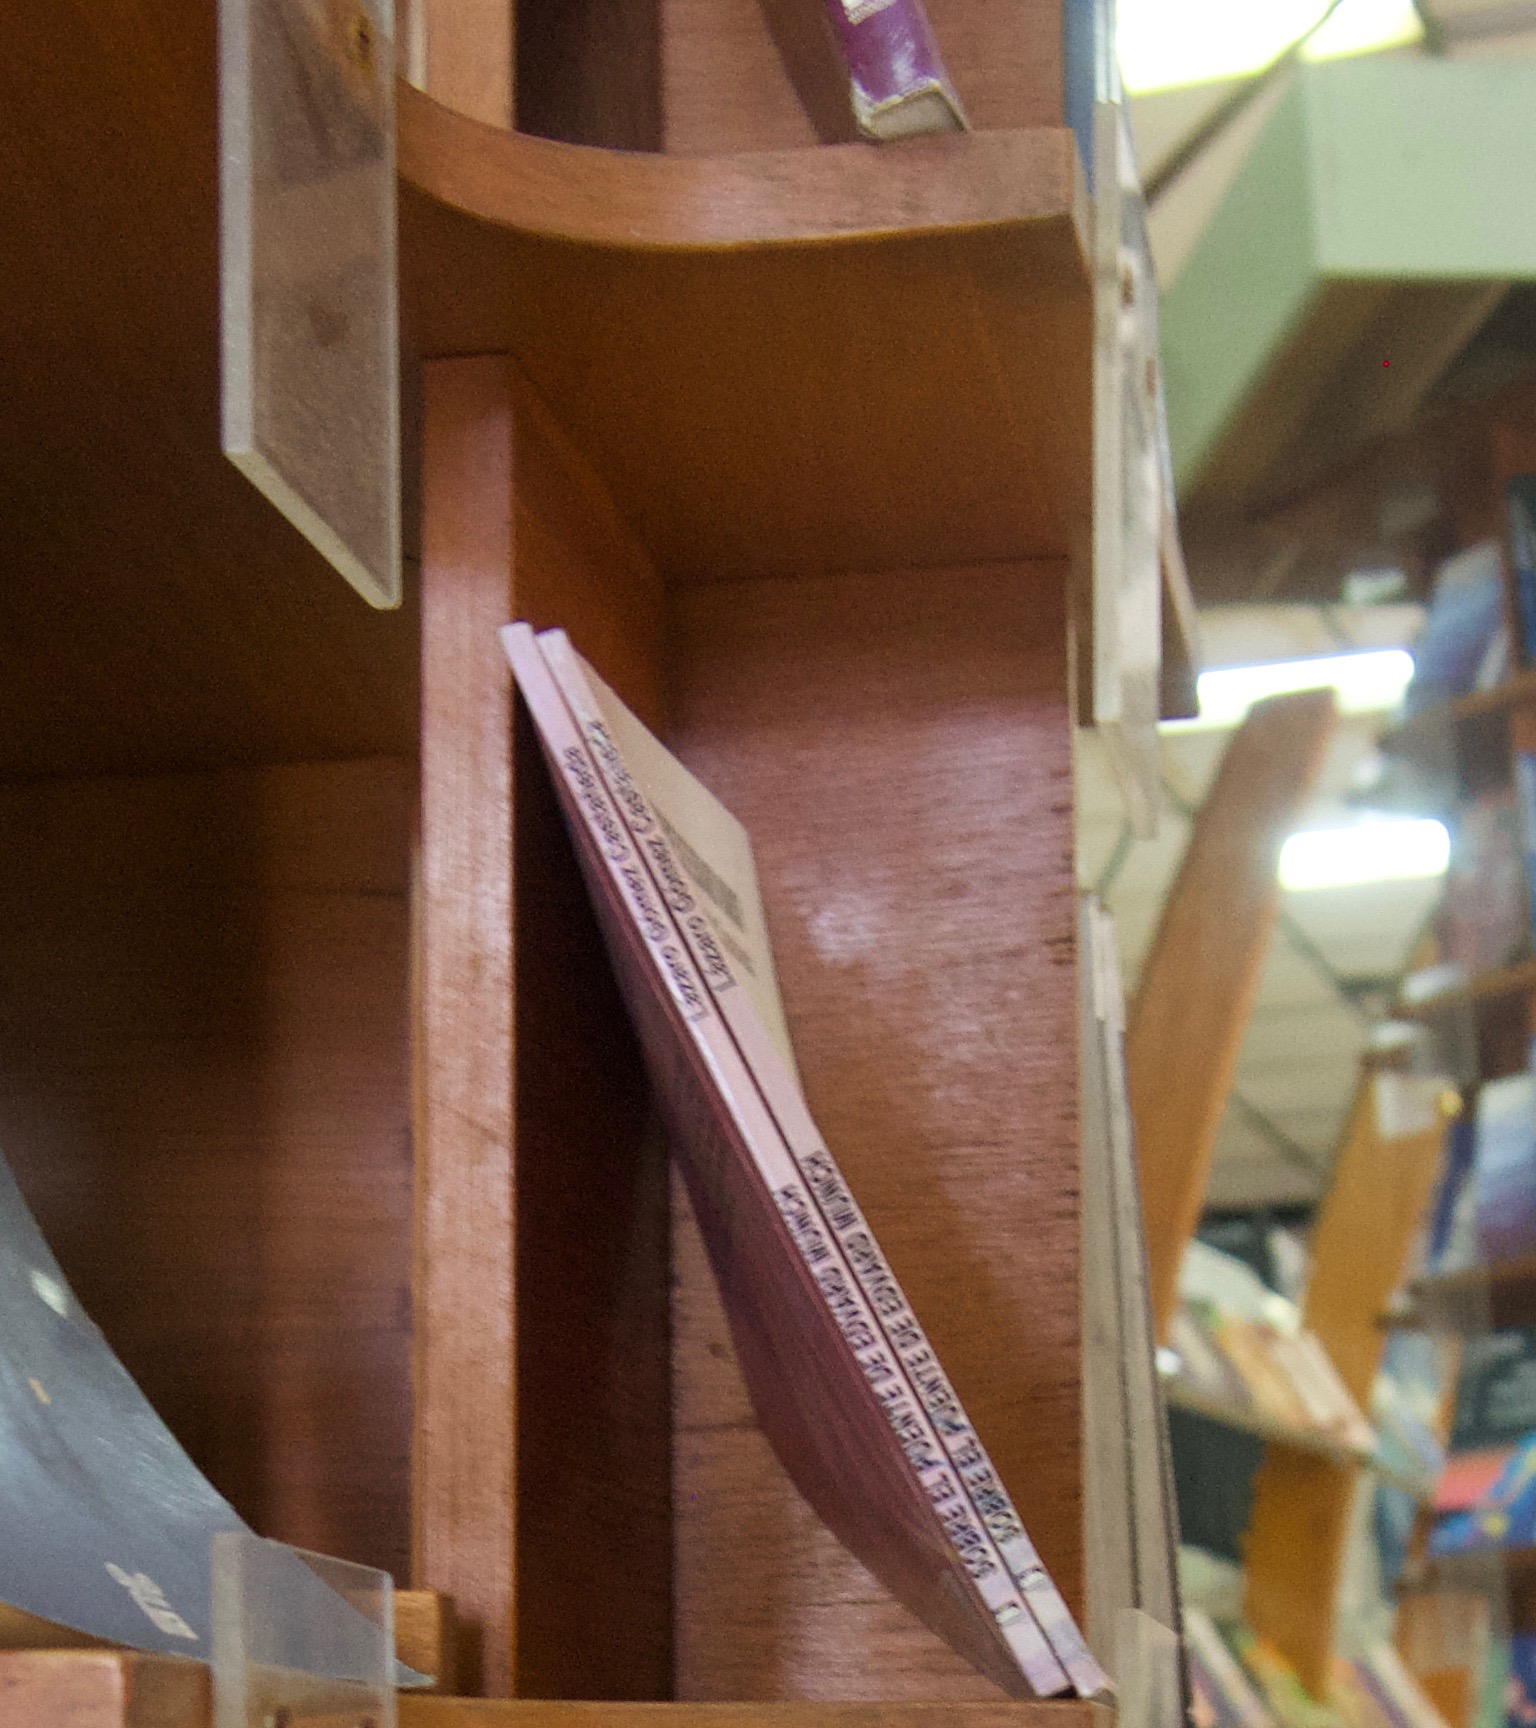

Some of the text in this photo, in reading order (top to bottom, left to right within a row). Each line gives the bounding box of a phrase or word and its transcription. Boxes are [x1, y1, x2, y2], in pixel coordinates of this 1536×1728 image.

[889, 1316, 921, 1349] DE
[863, 1351, 894, 1385] DE
[907, 1350, 967, 1437] PUENTE
[880, 1385, 942, 1472] PUENTE
[952, 1438, 983, 1468] EL
[926, 1471, 957, 1504] EL
[968, 1467, 1022, 1544] SOBRE
[940, 1504, 996, 1580] SOBRE
